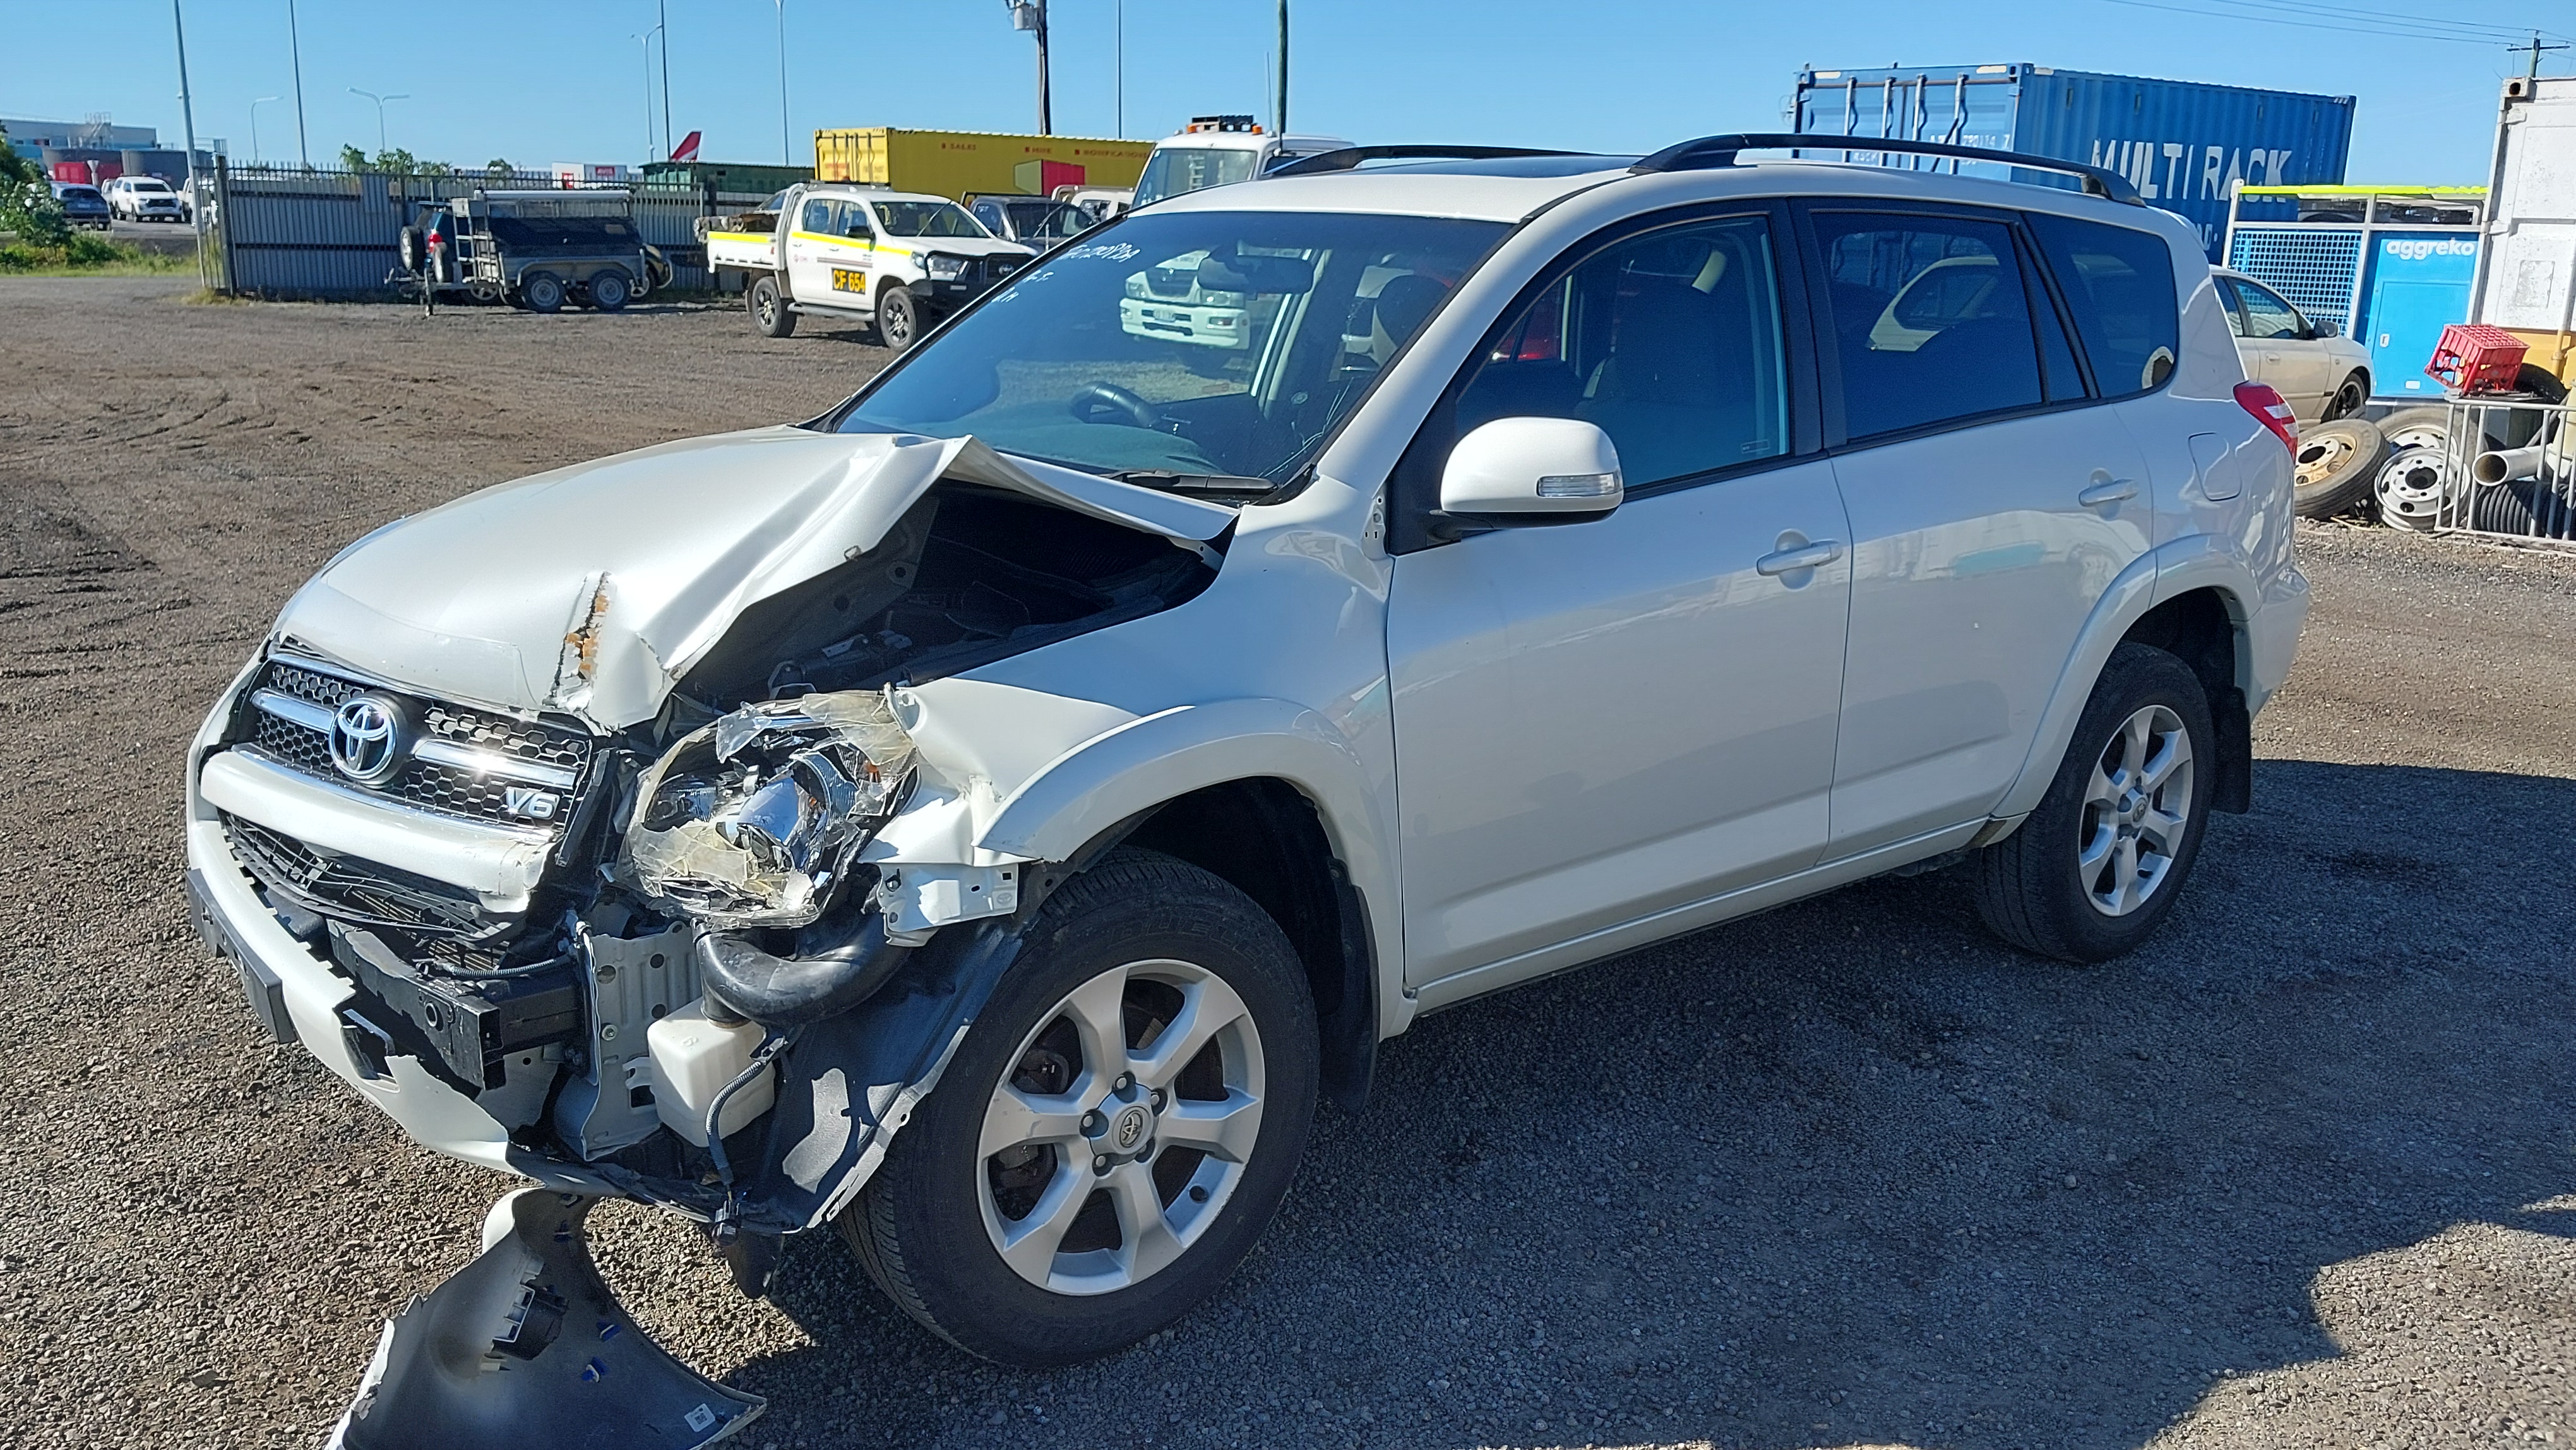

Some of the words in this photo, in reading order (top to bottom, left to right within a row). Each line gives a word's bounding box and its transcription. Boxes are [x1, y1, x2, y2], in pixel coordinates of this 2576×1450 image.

[2091, 139, 2194, 200] MULTI
[2201, 146, 2293, 203] RACK
[2386, 237, 2475, 260] aggreko
[833, 270, 847, 290] CF
[848, 272, 865, 292] 654
[506, 787, 556, 818] V6
